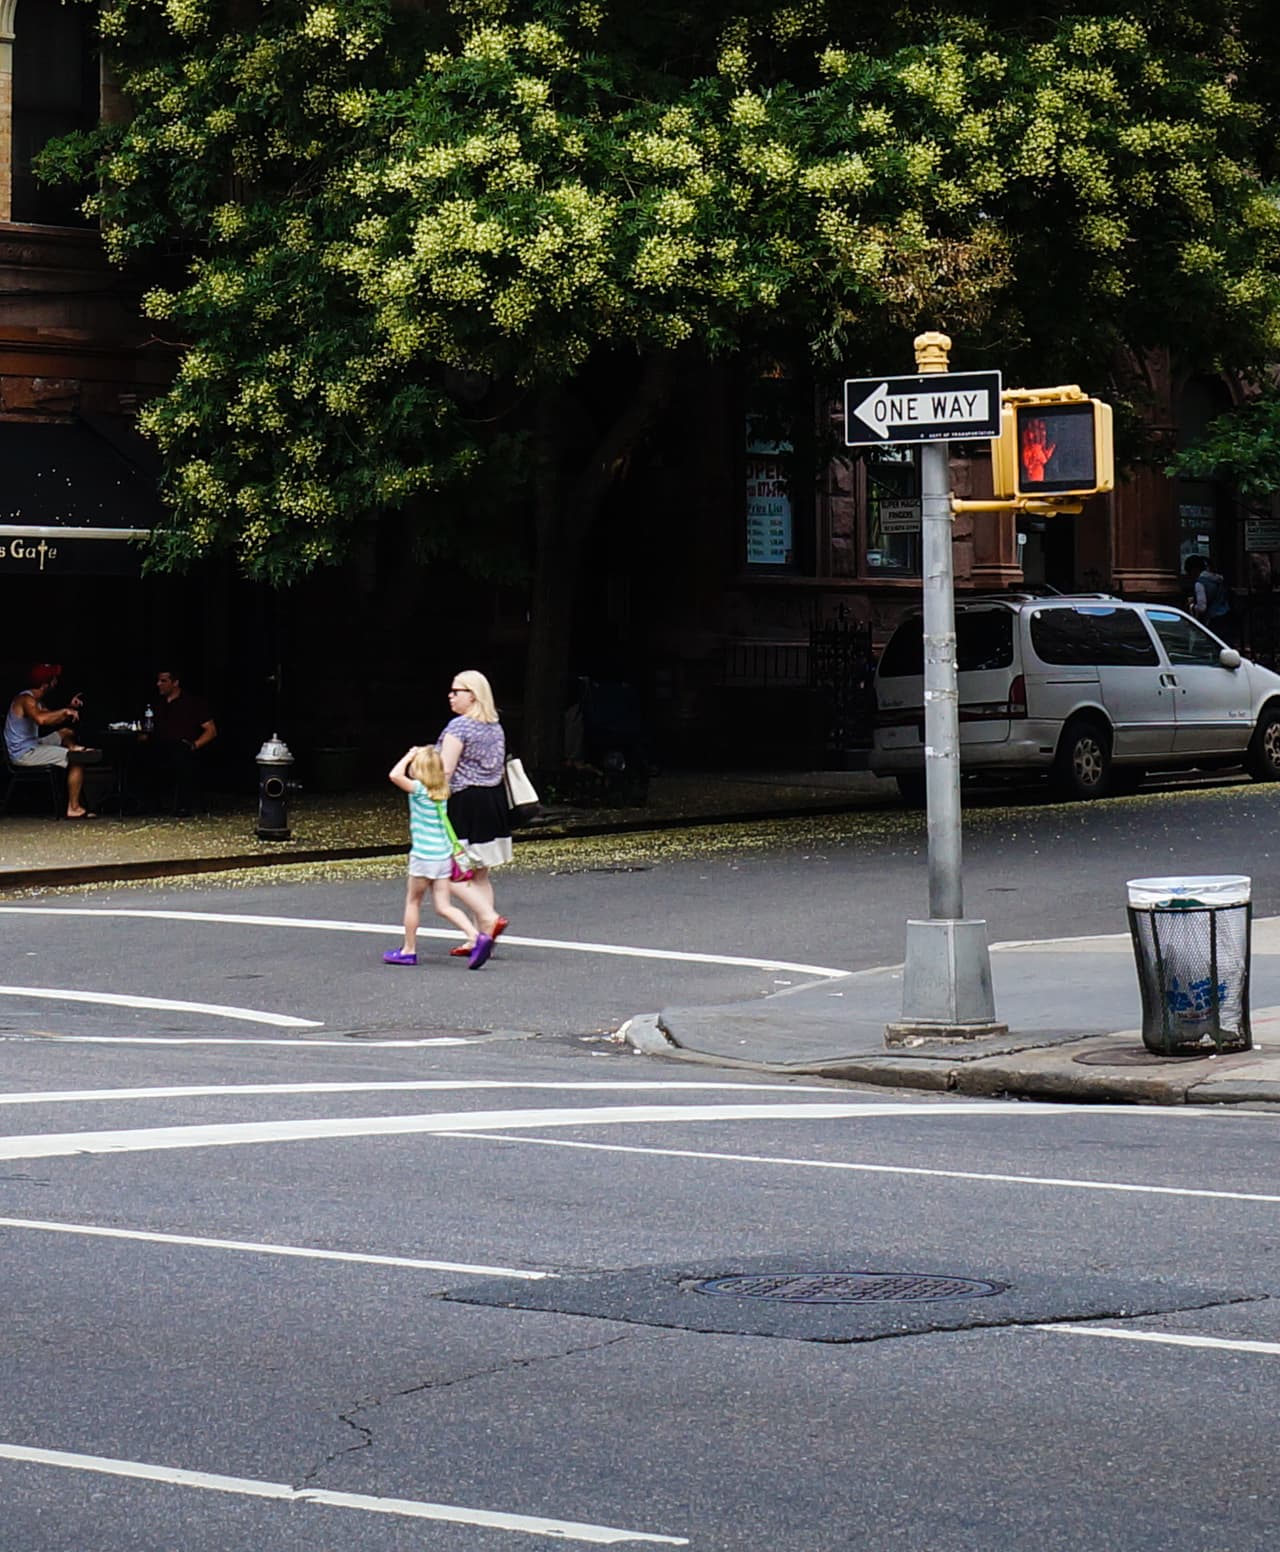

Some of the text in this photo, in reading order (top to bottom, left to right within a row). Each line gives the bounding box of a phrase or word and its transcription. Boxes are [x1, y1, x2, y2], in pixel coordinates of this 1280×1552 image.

[874, 394, 978, 423] ONE WAY
[10, 539, 57, 570] Gate
